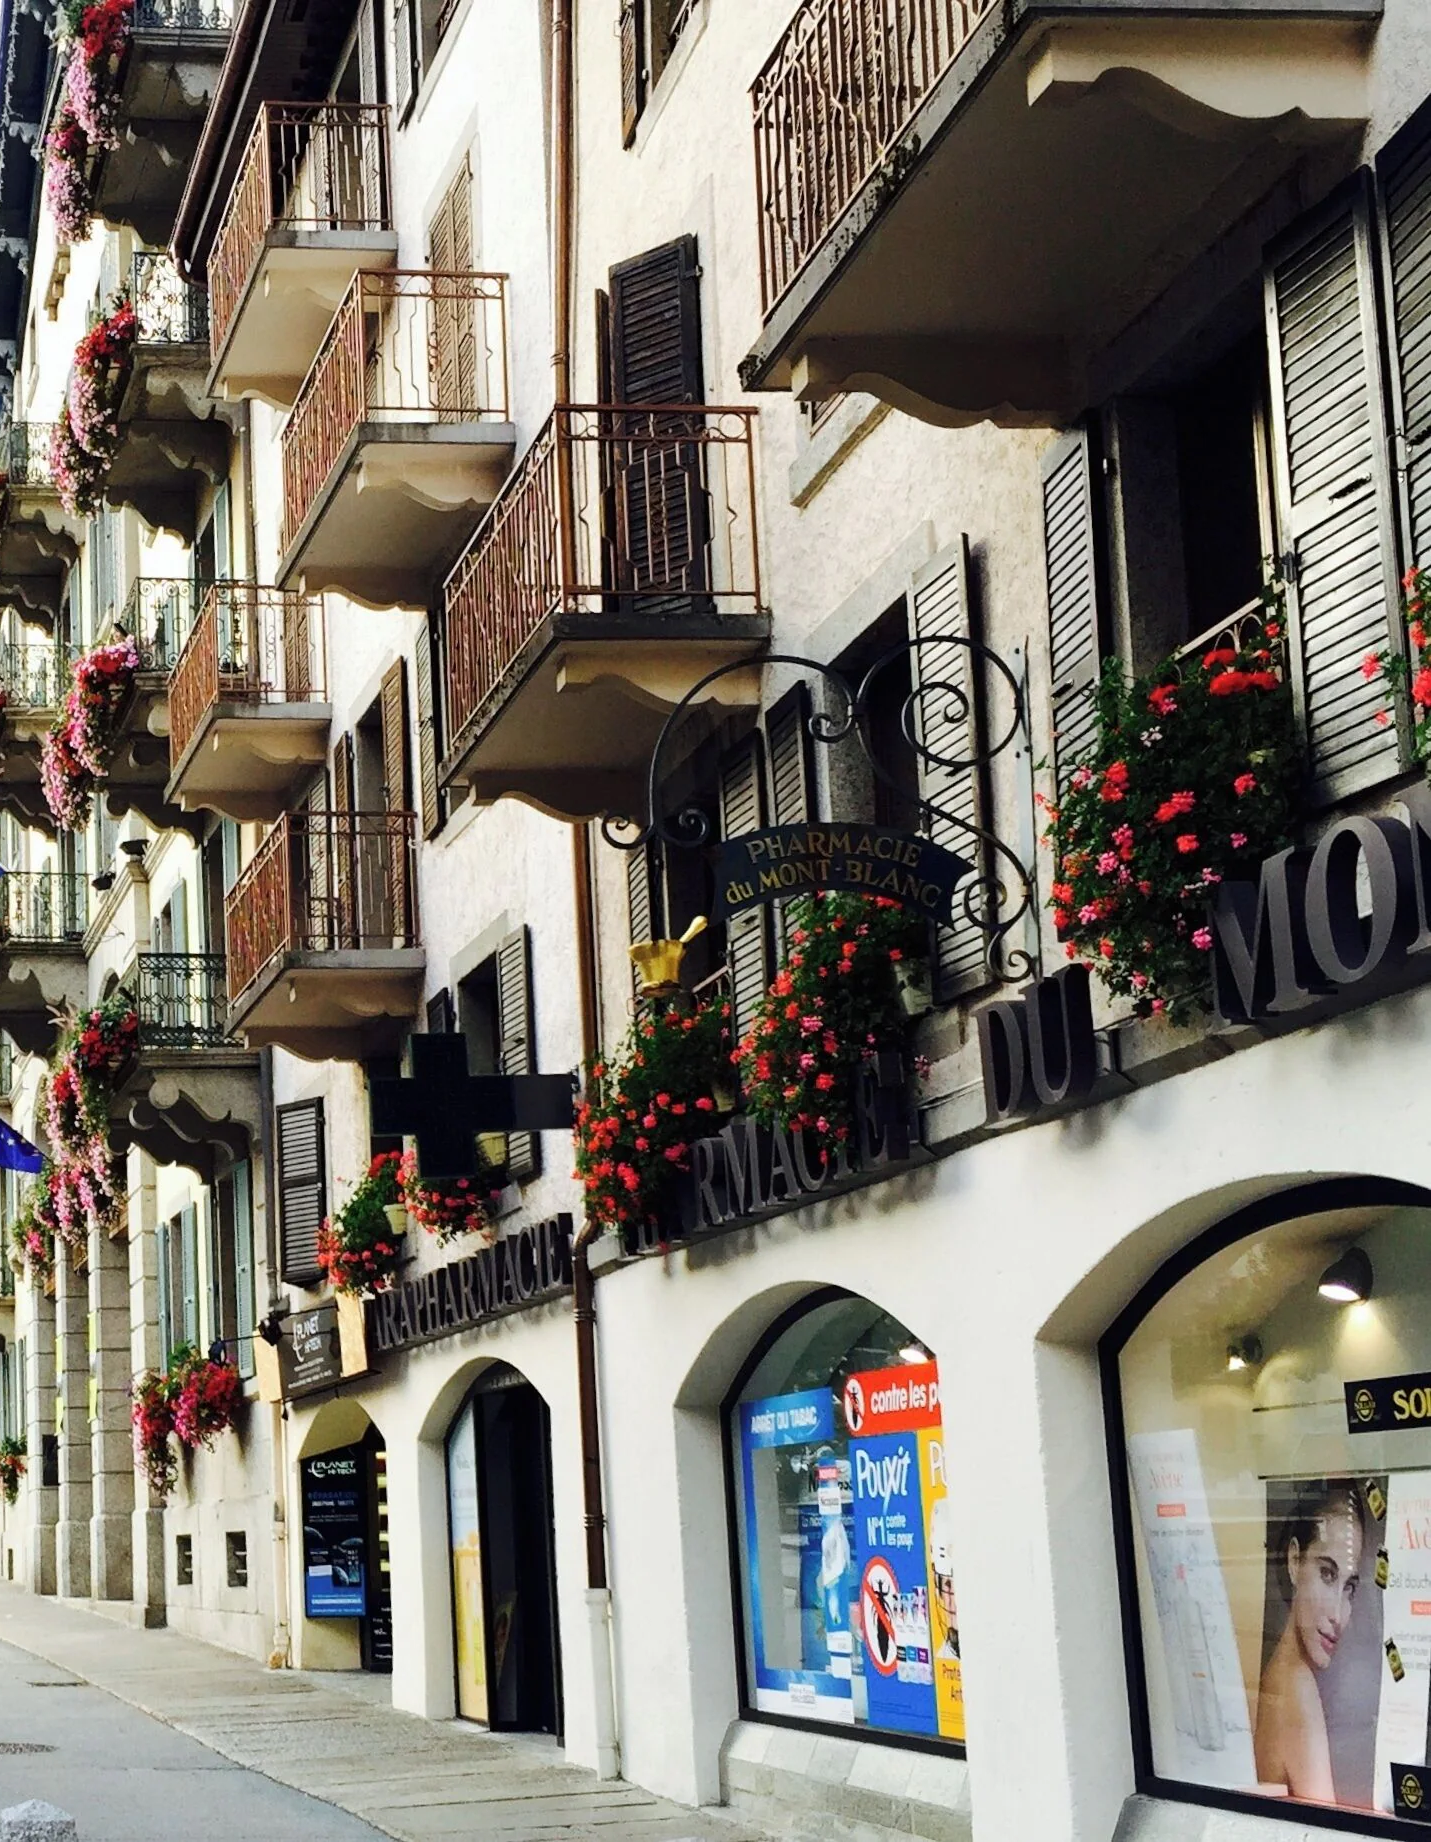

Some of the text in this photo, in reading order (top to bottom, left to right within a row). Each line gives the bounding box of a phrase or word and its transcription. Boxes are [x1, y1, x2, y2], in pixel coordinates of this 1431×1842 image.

[745, 831, 923, 867] PHARMACIE
[726, 880, 754, 904] du
[972, 963, 1090, 1128] DU
[871, 1383, 907, 1414] contre
[909, 1380, 926, 1410] les
[316, 1461, 355, 1469] PLANET
[856, 1446, 911, 1516] Pouxit
